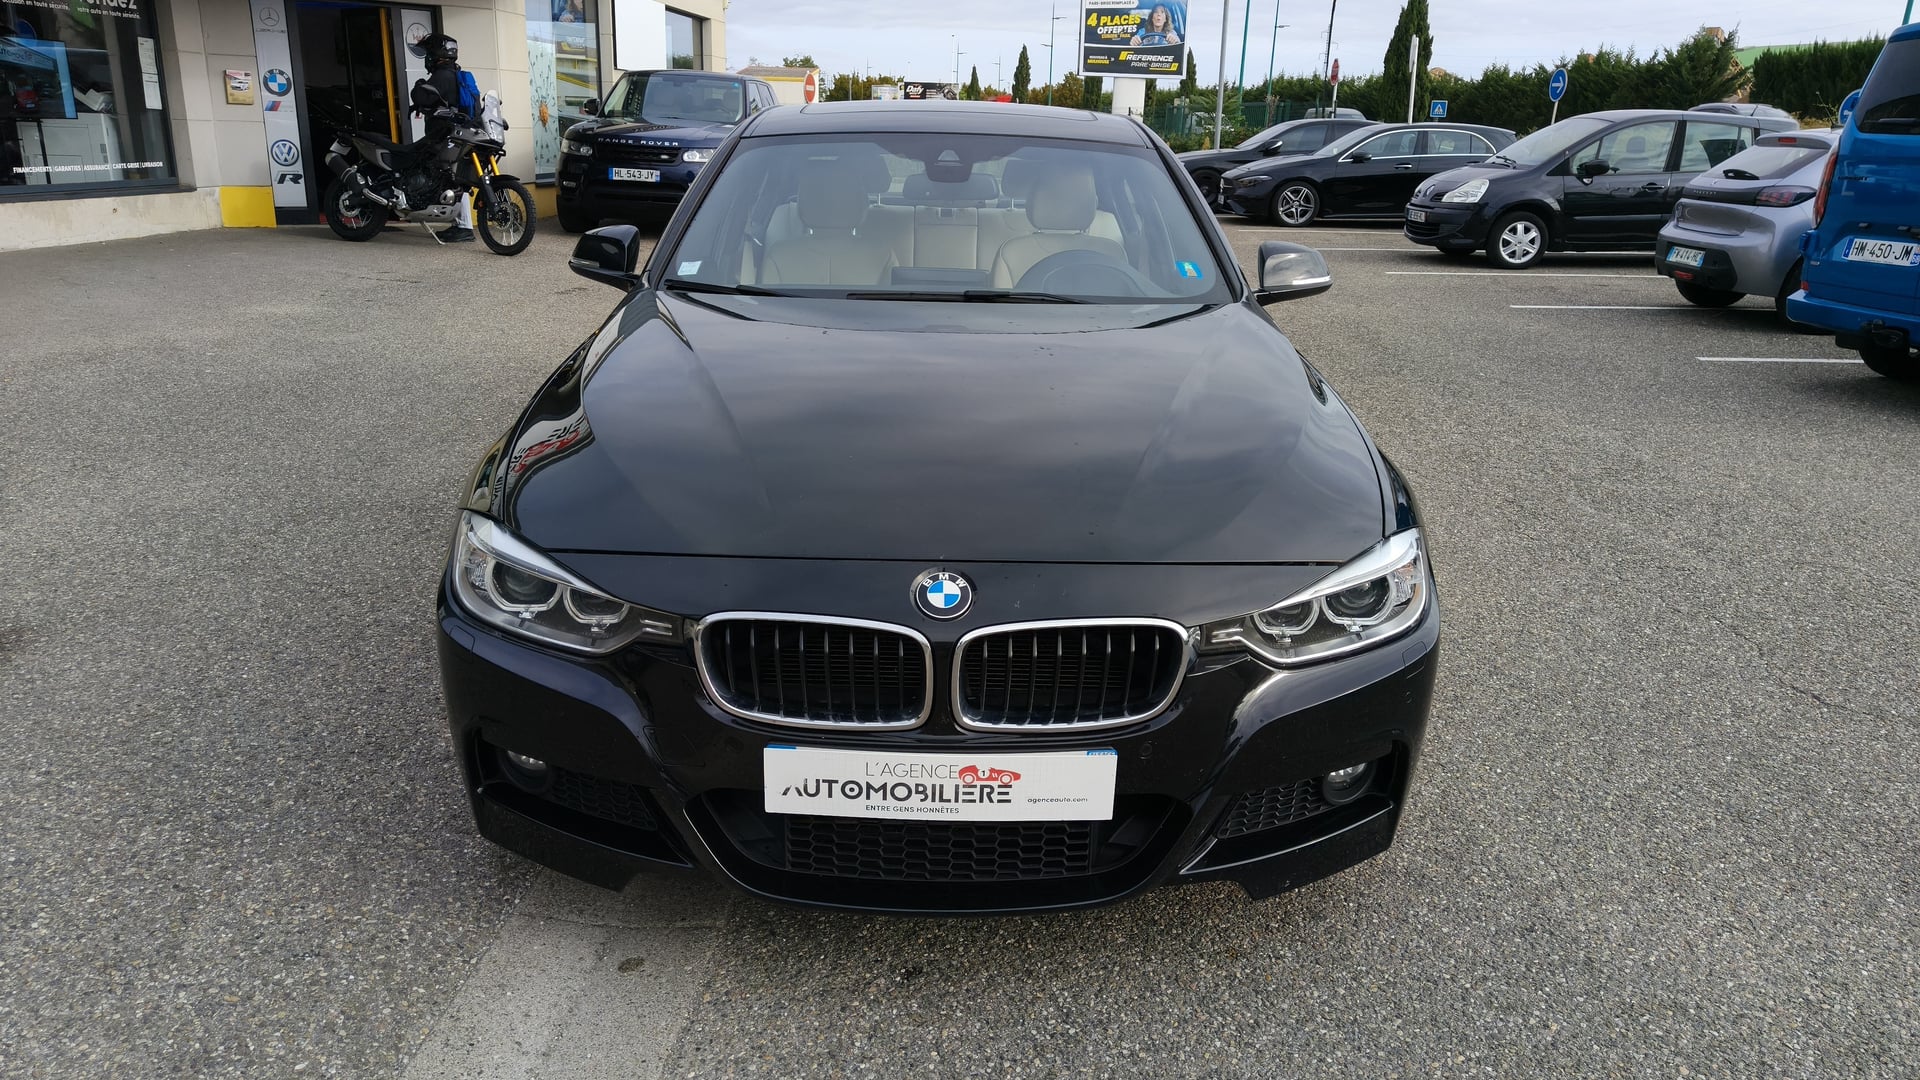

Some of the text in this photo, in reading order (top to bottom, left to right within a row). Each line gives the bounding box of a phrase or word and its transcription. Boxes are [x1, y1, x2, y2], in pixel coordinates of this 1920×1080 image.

[1087, 13, 1141, 27] 4 PLACES
[1097, 25, 1137, 34] OFFERTES
[1126, 54, 1175, 62] REFERENCE
[1851, 240, 1914, 262] HM-450-JM
[922, 572, 967, 588] BMW
[865, 761, 959, 780] L'AGENCE
[1027, 797, 1088, 805] agenceauto.com
[865, 804, 960, 814] ENTRE GENS HONNÊTES
